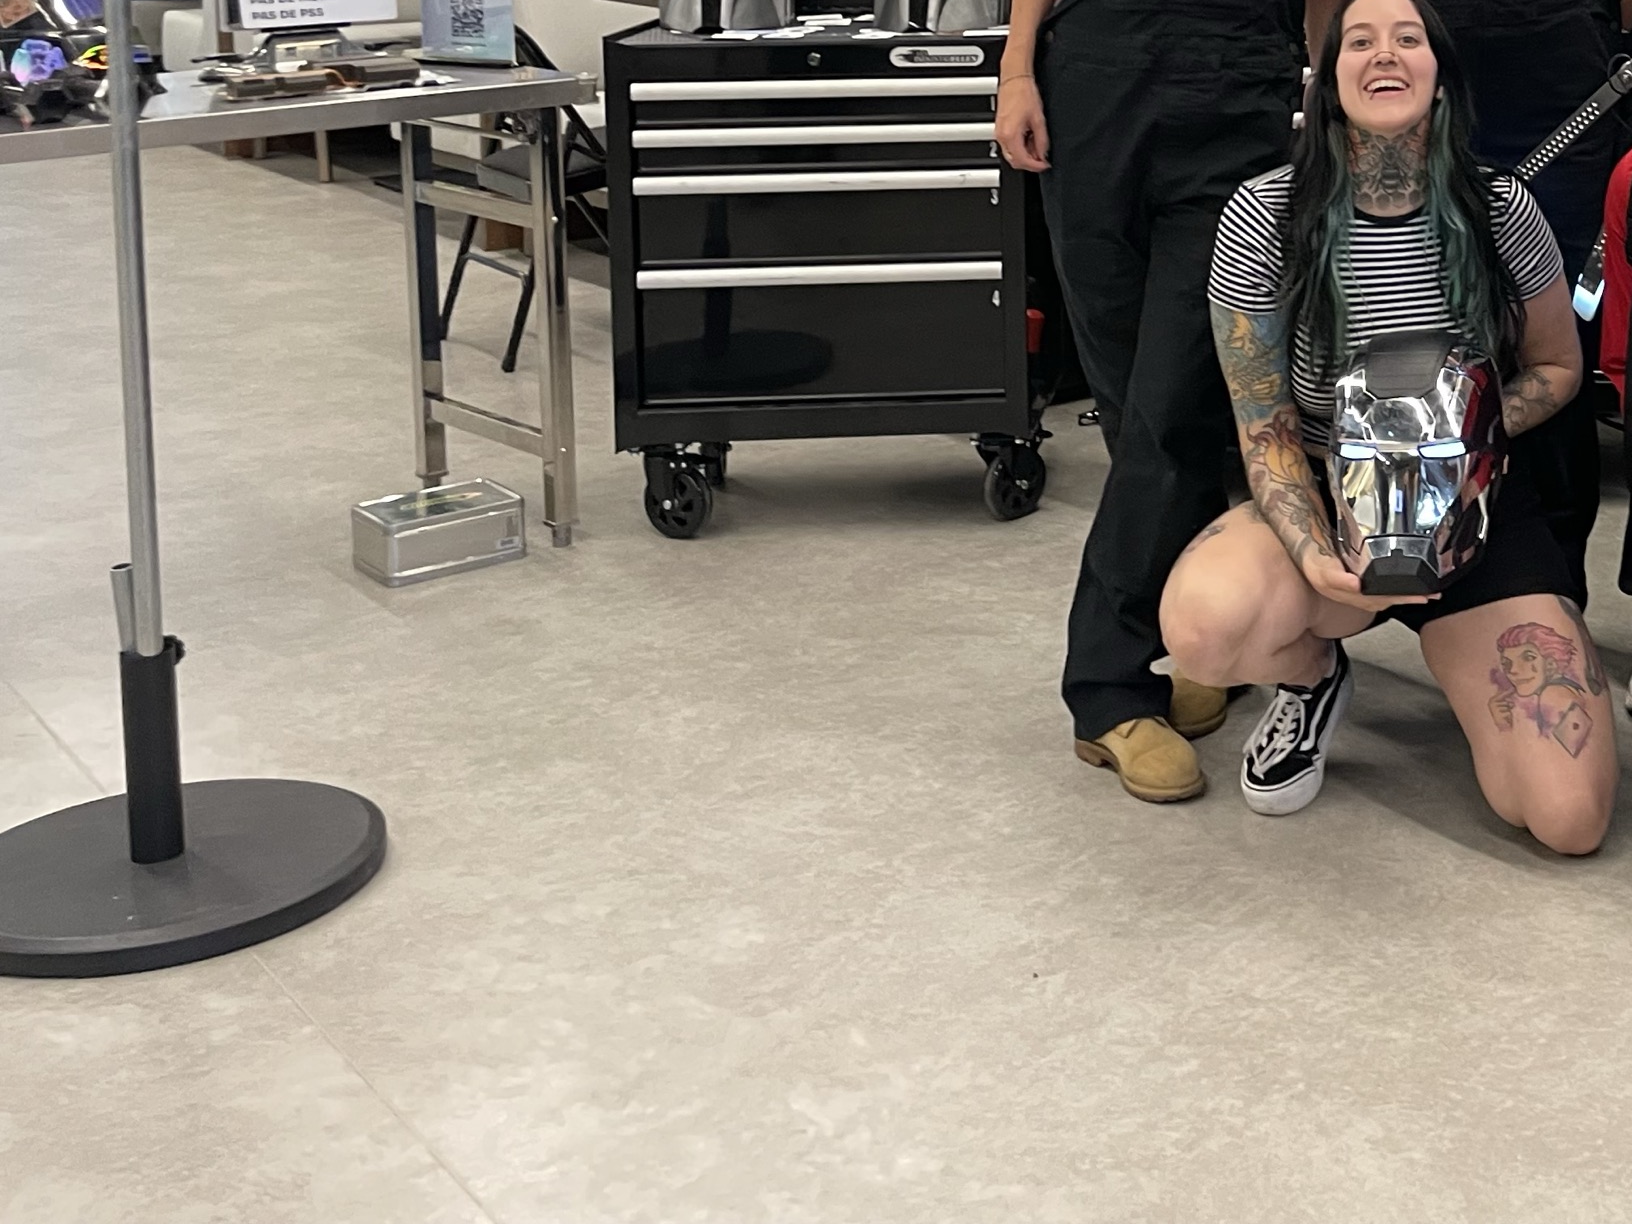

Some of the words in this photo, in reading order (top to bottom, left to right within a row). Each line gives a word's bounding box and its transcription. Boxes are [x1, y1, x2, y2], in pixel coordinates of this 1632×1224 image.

[252, 11, 277, 20] PAS
[280, 9, 297, 19] DE
[989, 141, 998, 157] 2
[990, 188, 999, 205] 3
